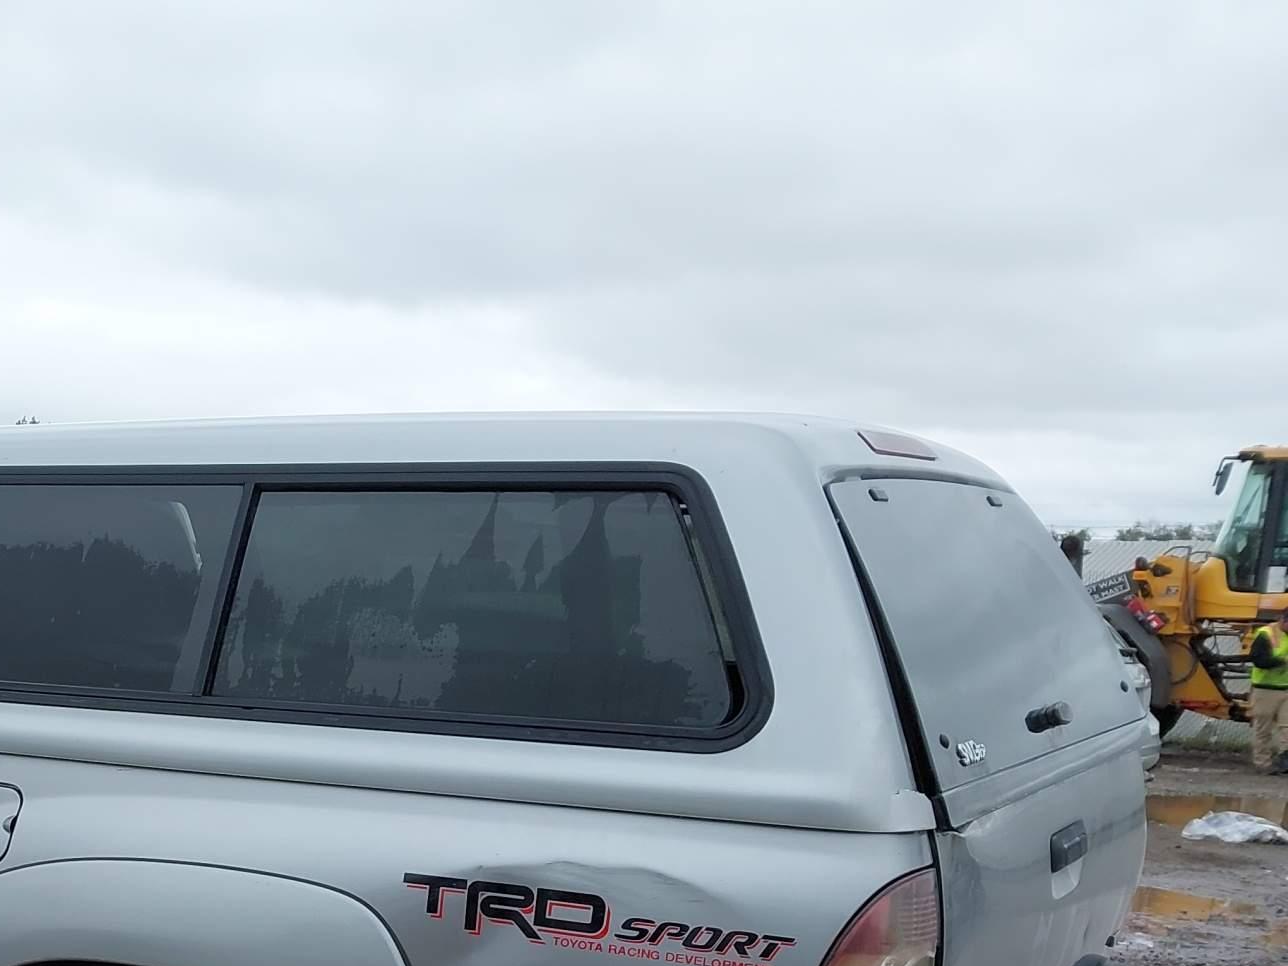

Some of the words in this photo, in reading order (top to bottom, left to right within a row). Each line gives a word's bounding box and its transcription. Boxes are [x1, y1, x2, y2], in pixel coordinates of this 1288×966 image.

[403, 872, 610, 945] TRD
[614, 917, 797, 961] SPORT
[552, 936, 603, 953] TOYOTA
[608, 944, 660, 961] RACING
